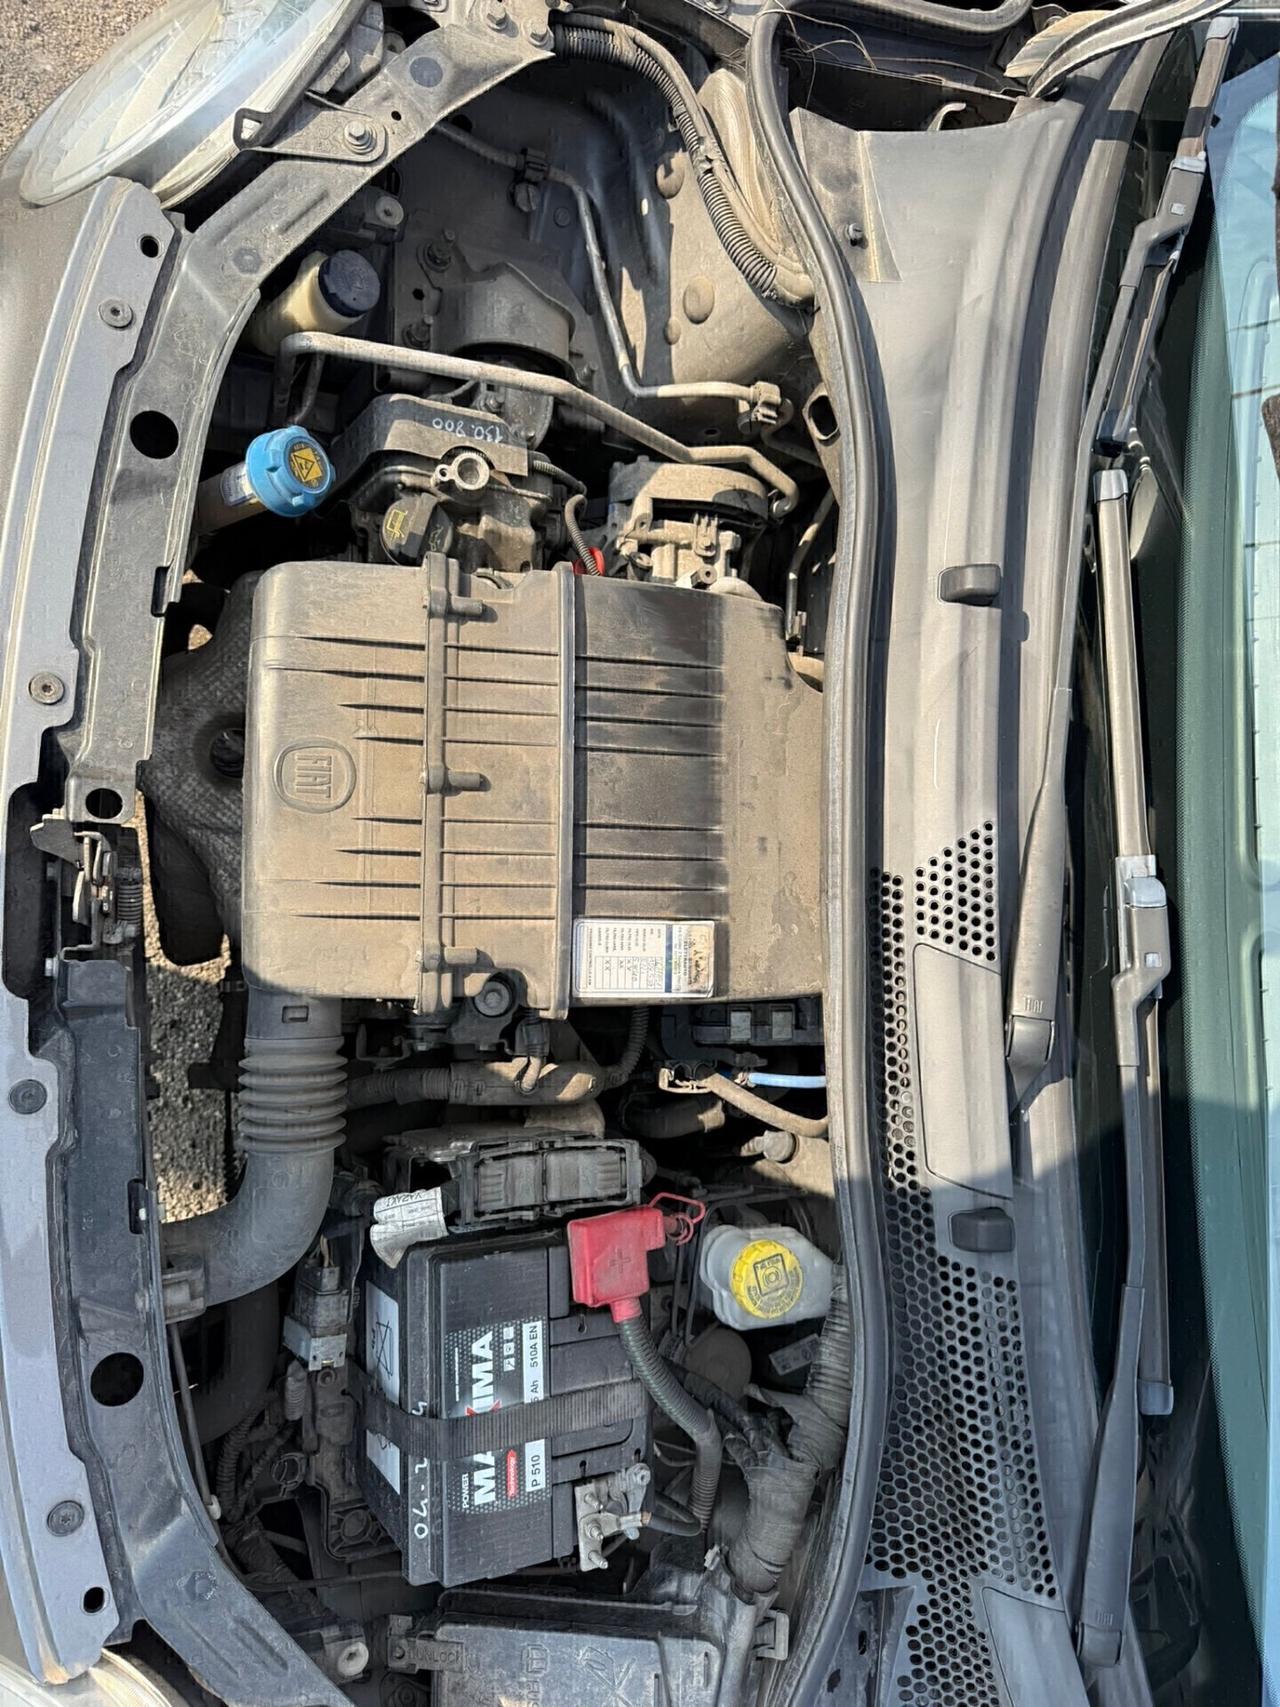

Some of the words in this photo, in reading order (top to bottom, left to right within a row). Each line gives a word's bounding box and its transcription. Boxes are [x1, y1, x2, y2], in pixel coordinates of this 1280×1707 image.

[295, 753, 332, 799] FIAT
[528, 1325, 538, 1340] EN
[528, 1342, 539, 1368] 510A
[529, 1379, 539, 1394] Ah
[531, 1455, 541, 1476] 510
[461, 1473, 470, 1509] POWER
[532, 1479, 541, 1488] P
